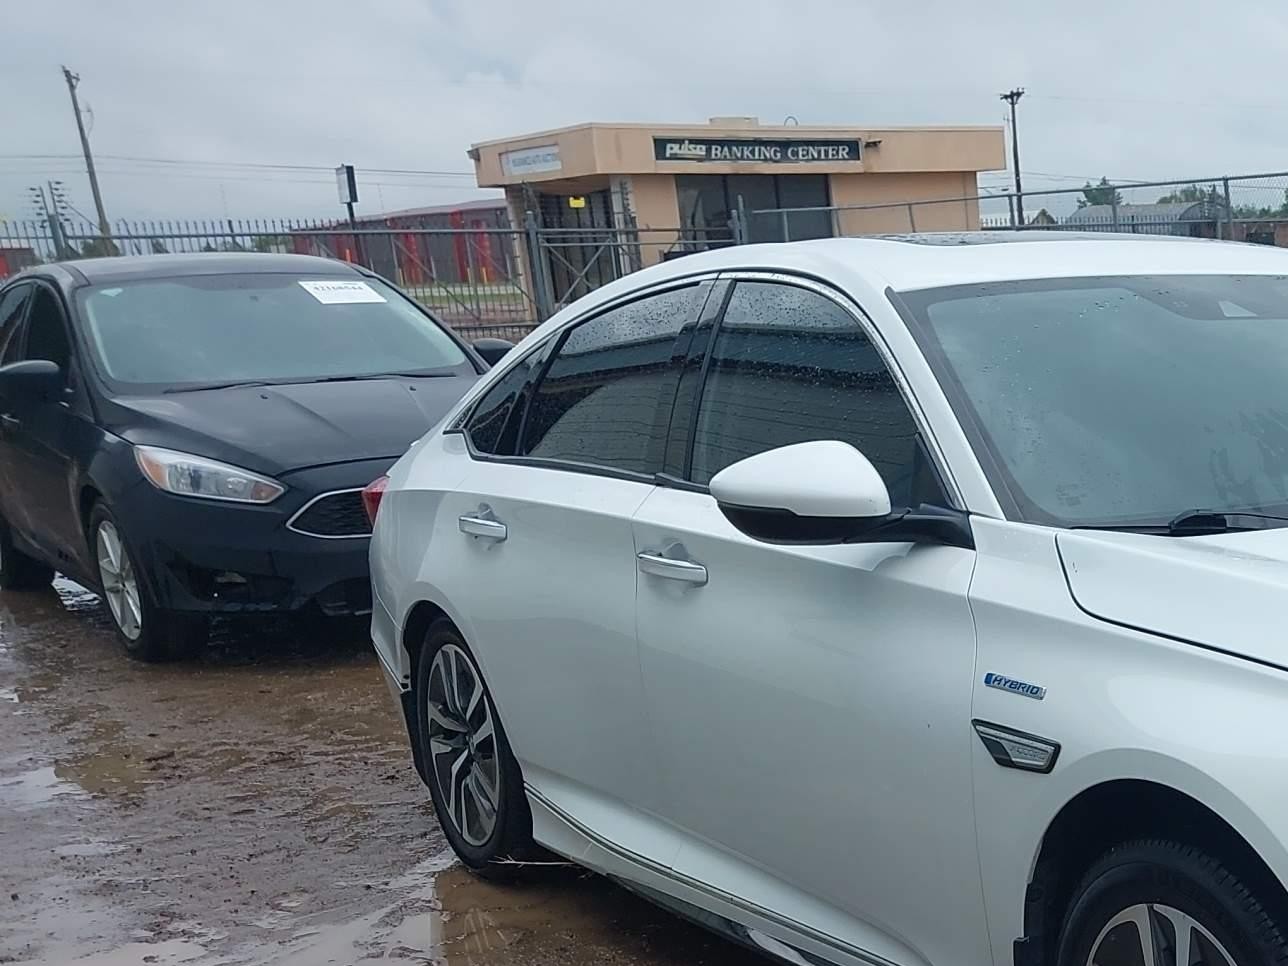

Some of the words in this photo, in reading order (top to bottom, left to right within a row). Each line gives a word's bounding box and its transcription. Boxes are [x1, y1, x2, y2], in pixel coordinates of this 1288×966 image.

[665, 140, 706, 158] pulse
[711, 145, 781, 160] BANKING
[787, 145, 850, 160] CENTER
[991, 674, 1041, 696] HYBRID
